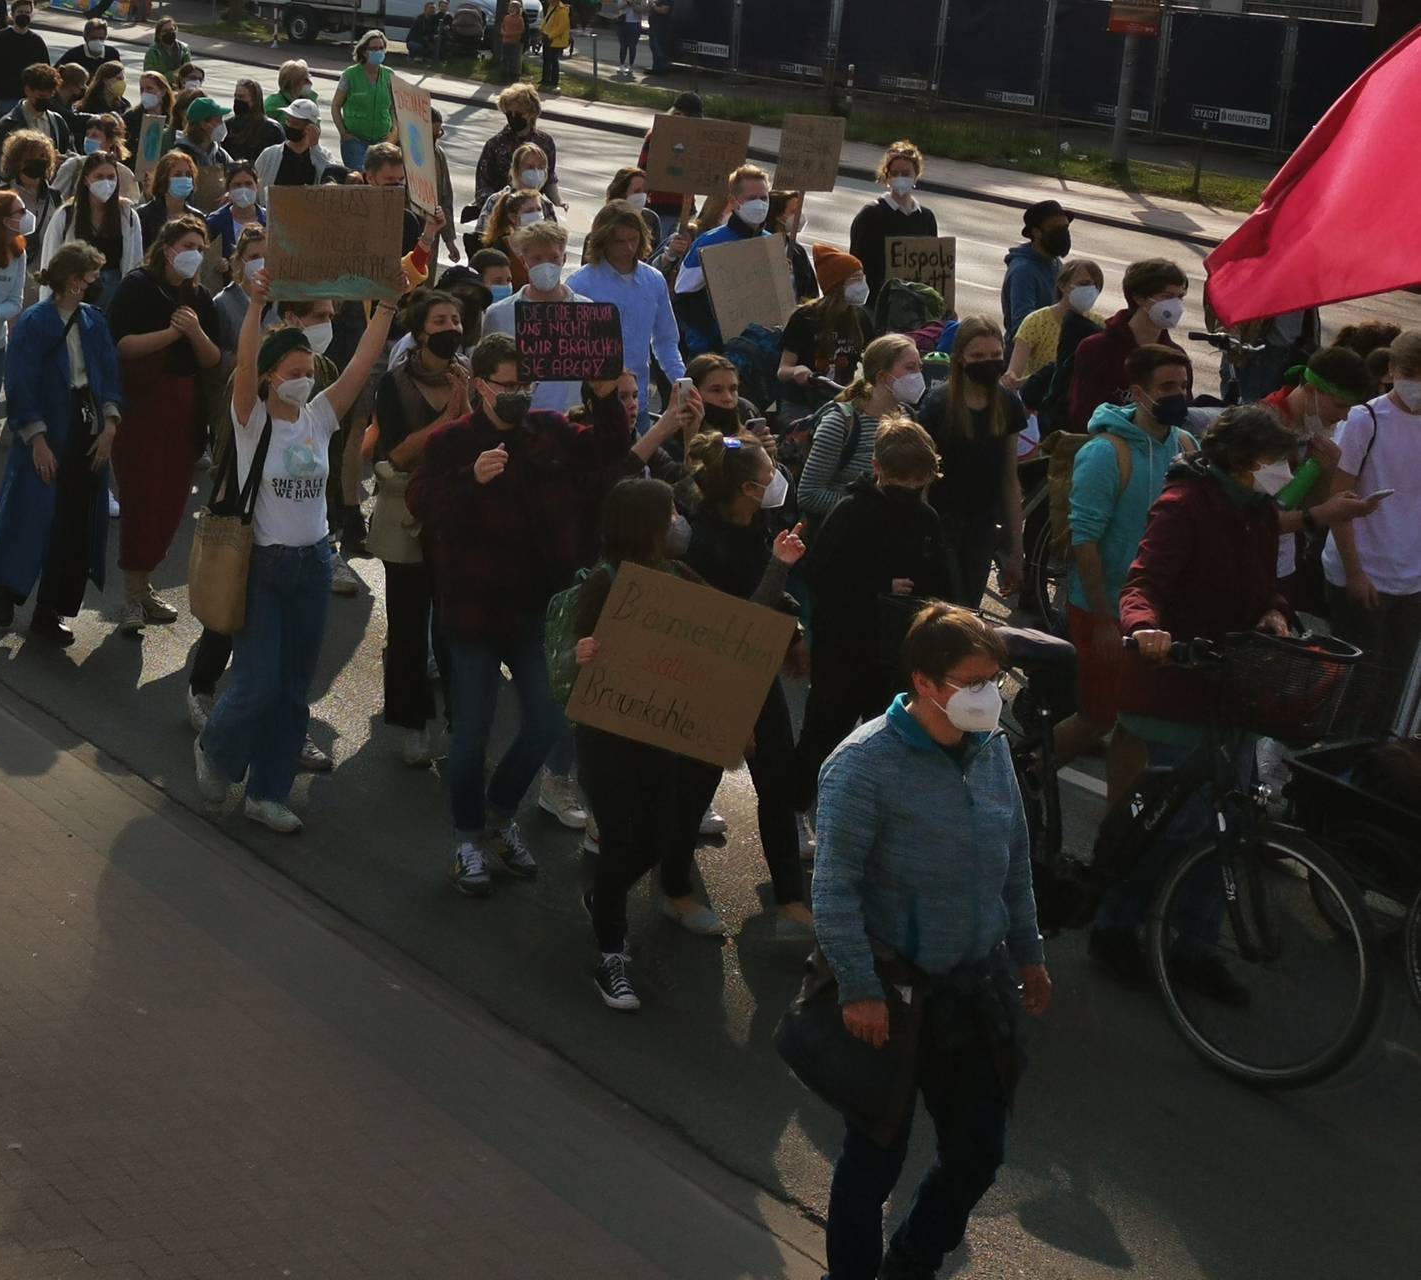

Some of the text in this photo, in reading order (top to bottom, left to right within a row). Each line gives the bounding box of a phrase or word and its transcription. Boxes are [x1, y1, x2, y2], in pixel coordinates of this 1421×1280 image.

[1193, 108, 1219, 121] STADT
[518, 321, 542, 337] UNS
[519, 338, 553, 355] WIR
[521, 357, 546, 378] SIE
[271, 477, 325, 490] SHE'S ALL
[274, 487, 322, 500] WE HAVE
